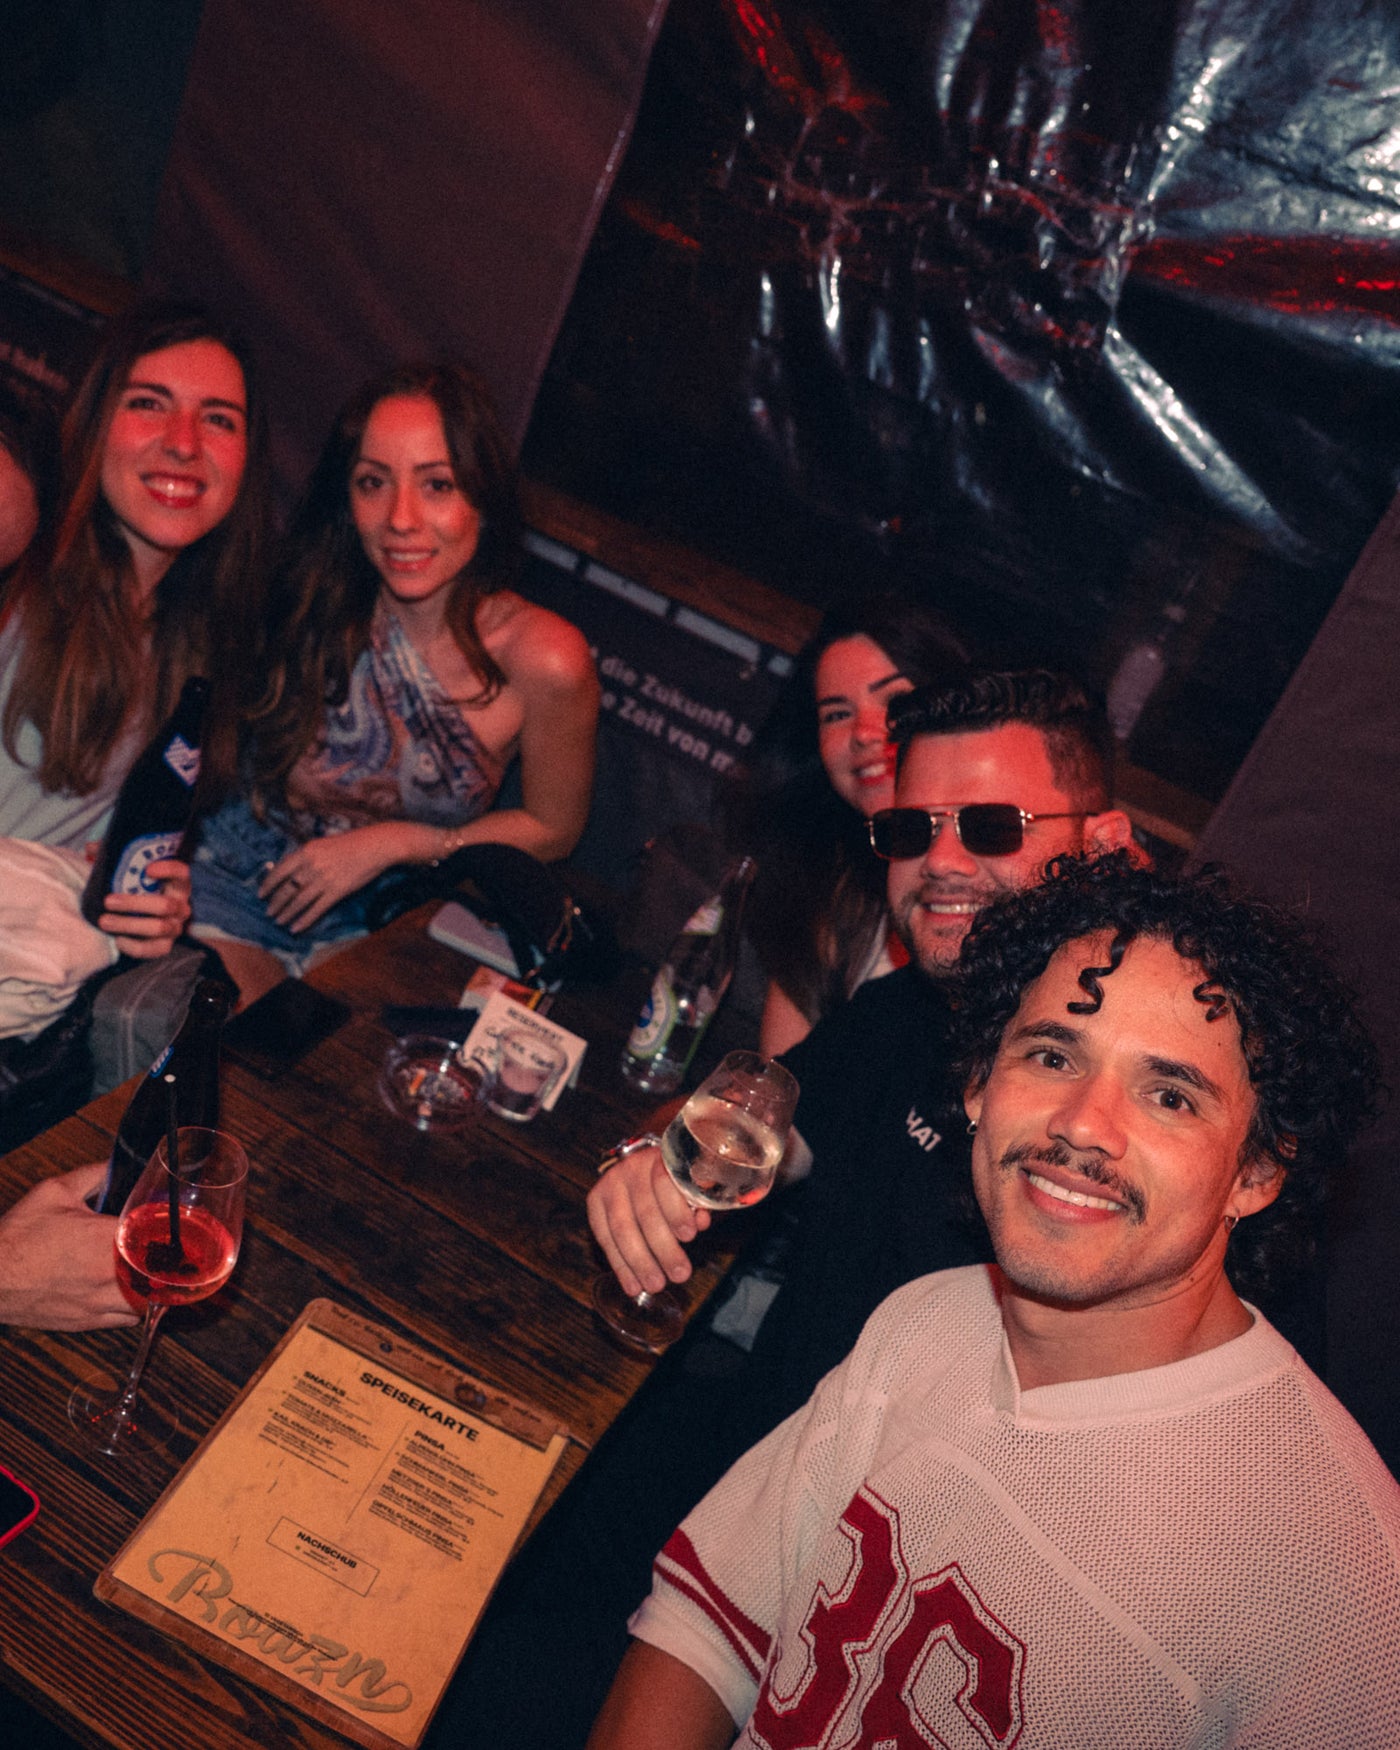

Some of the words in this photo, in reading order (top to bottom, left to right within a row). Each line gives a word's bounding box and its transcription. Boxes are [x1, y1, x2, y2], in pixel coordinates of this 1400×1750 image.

[600, 657, 638, 687] die
[640, 674, 733, 737] Zukunft
[618, 696, 665, 736] Zeit
[668, 726, 710, 761] von
[303, 1371, 347, 1397] SNACKS
[360, 1372, 479, 1442] SPEISEKARTE
[414, 1430, 446, 1451] PINSA
[297, 1531, 358, 1570] NACHSCHUB
